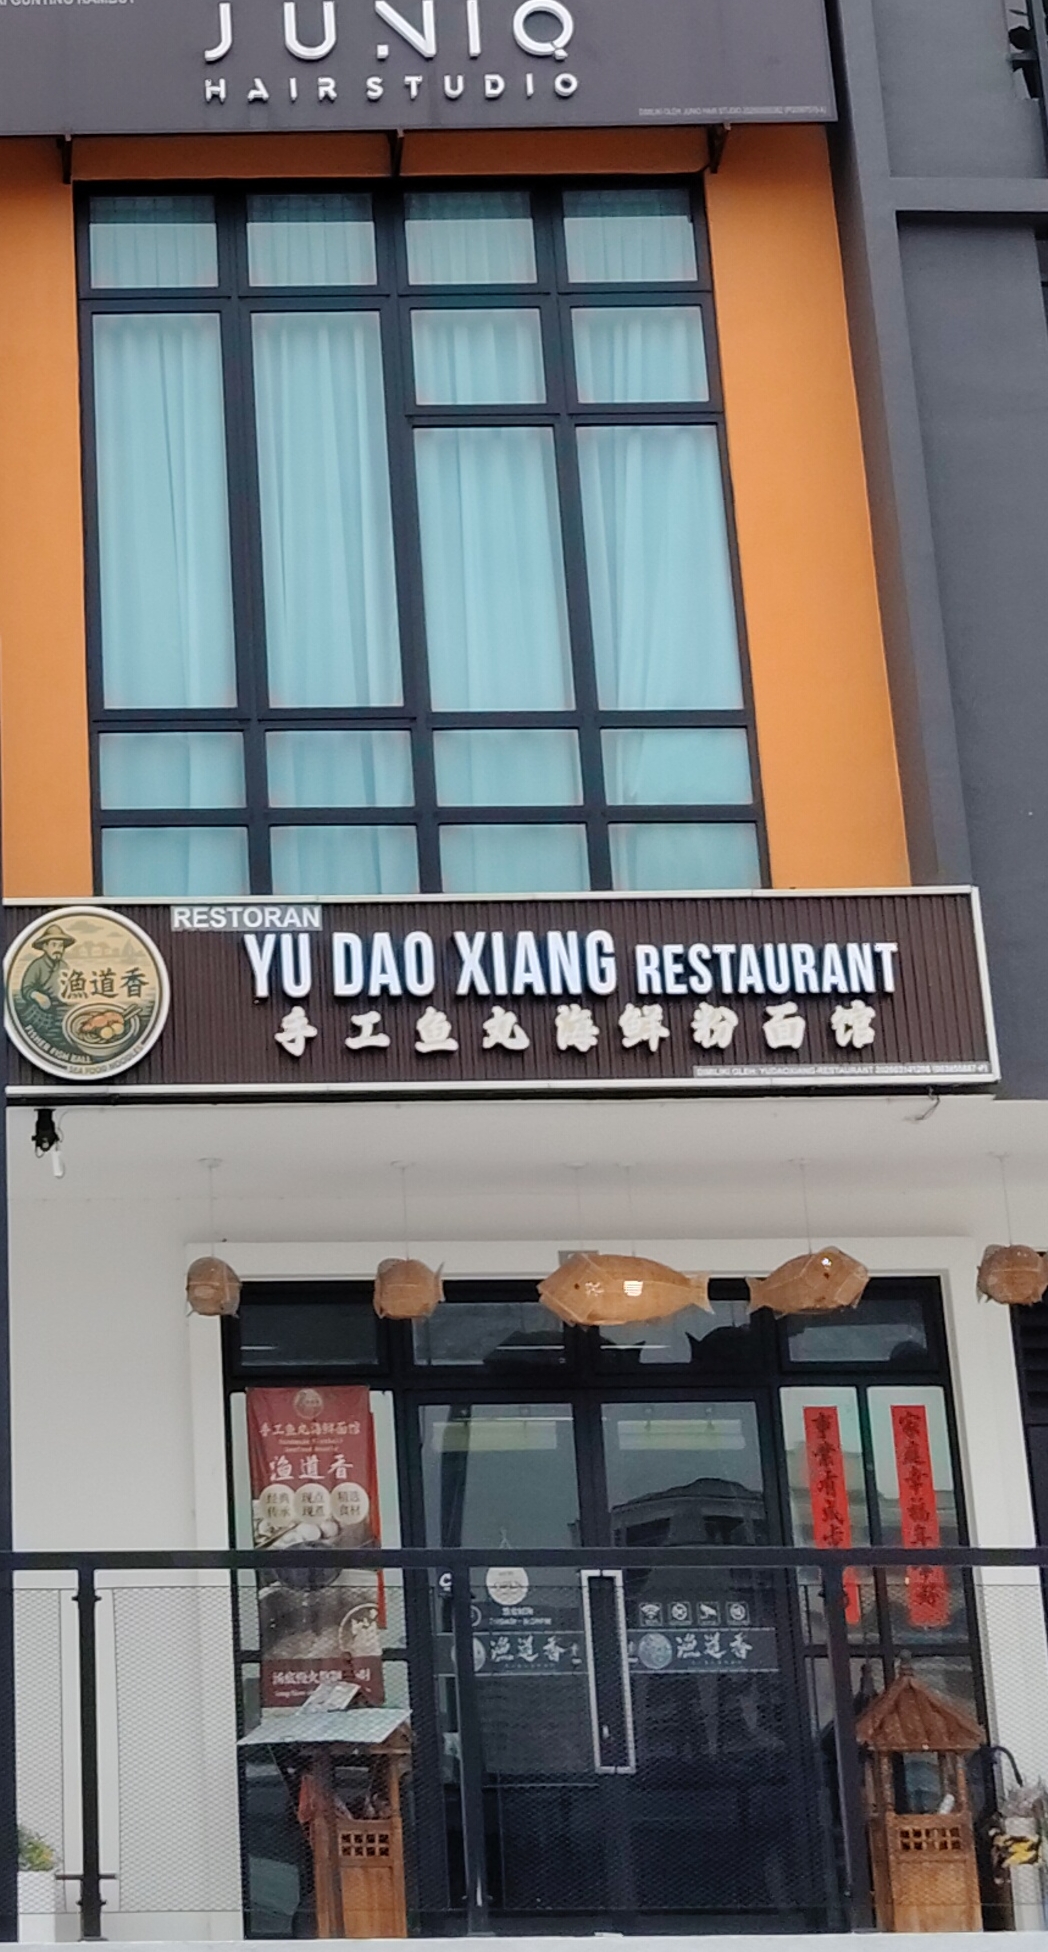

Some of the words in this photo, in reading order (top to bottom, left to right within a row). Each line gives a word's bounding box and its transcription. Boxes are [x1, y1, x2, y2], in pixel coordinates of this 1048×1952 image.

[173, 907, 322, 930] RESTORAN
[244, 933, 314, 999] YU
[333, 931, 436, 997] DAO
[454, 929, 617, 997] XIANG
[635, 942, 898, 995] RESTAURANT
[59, 967, 149, 1000] 漁道香
[274, 999, 876, 1057] 手工鱼丸海鲜粉面馆
[49, 1046, 70, 1061] FISH
[70, 1053, 92, 1064] BALL
[67, 1065, 82, 1074] SEA
